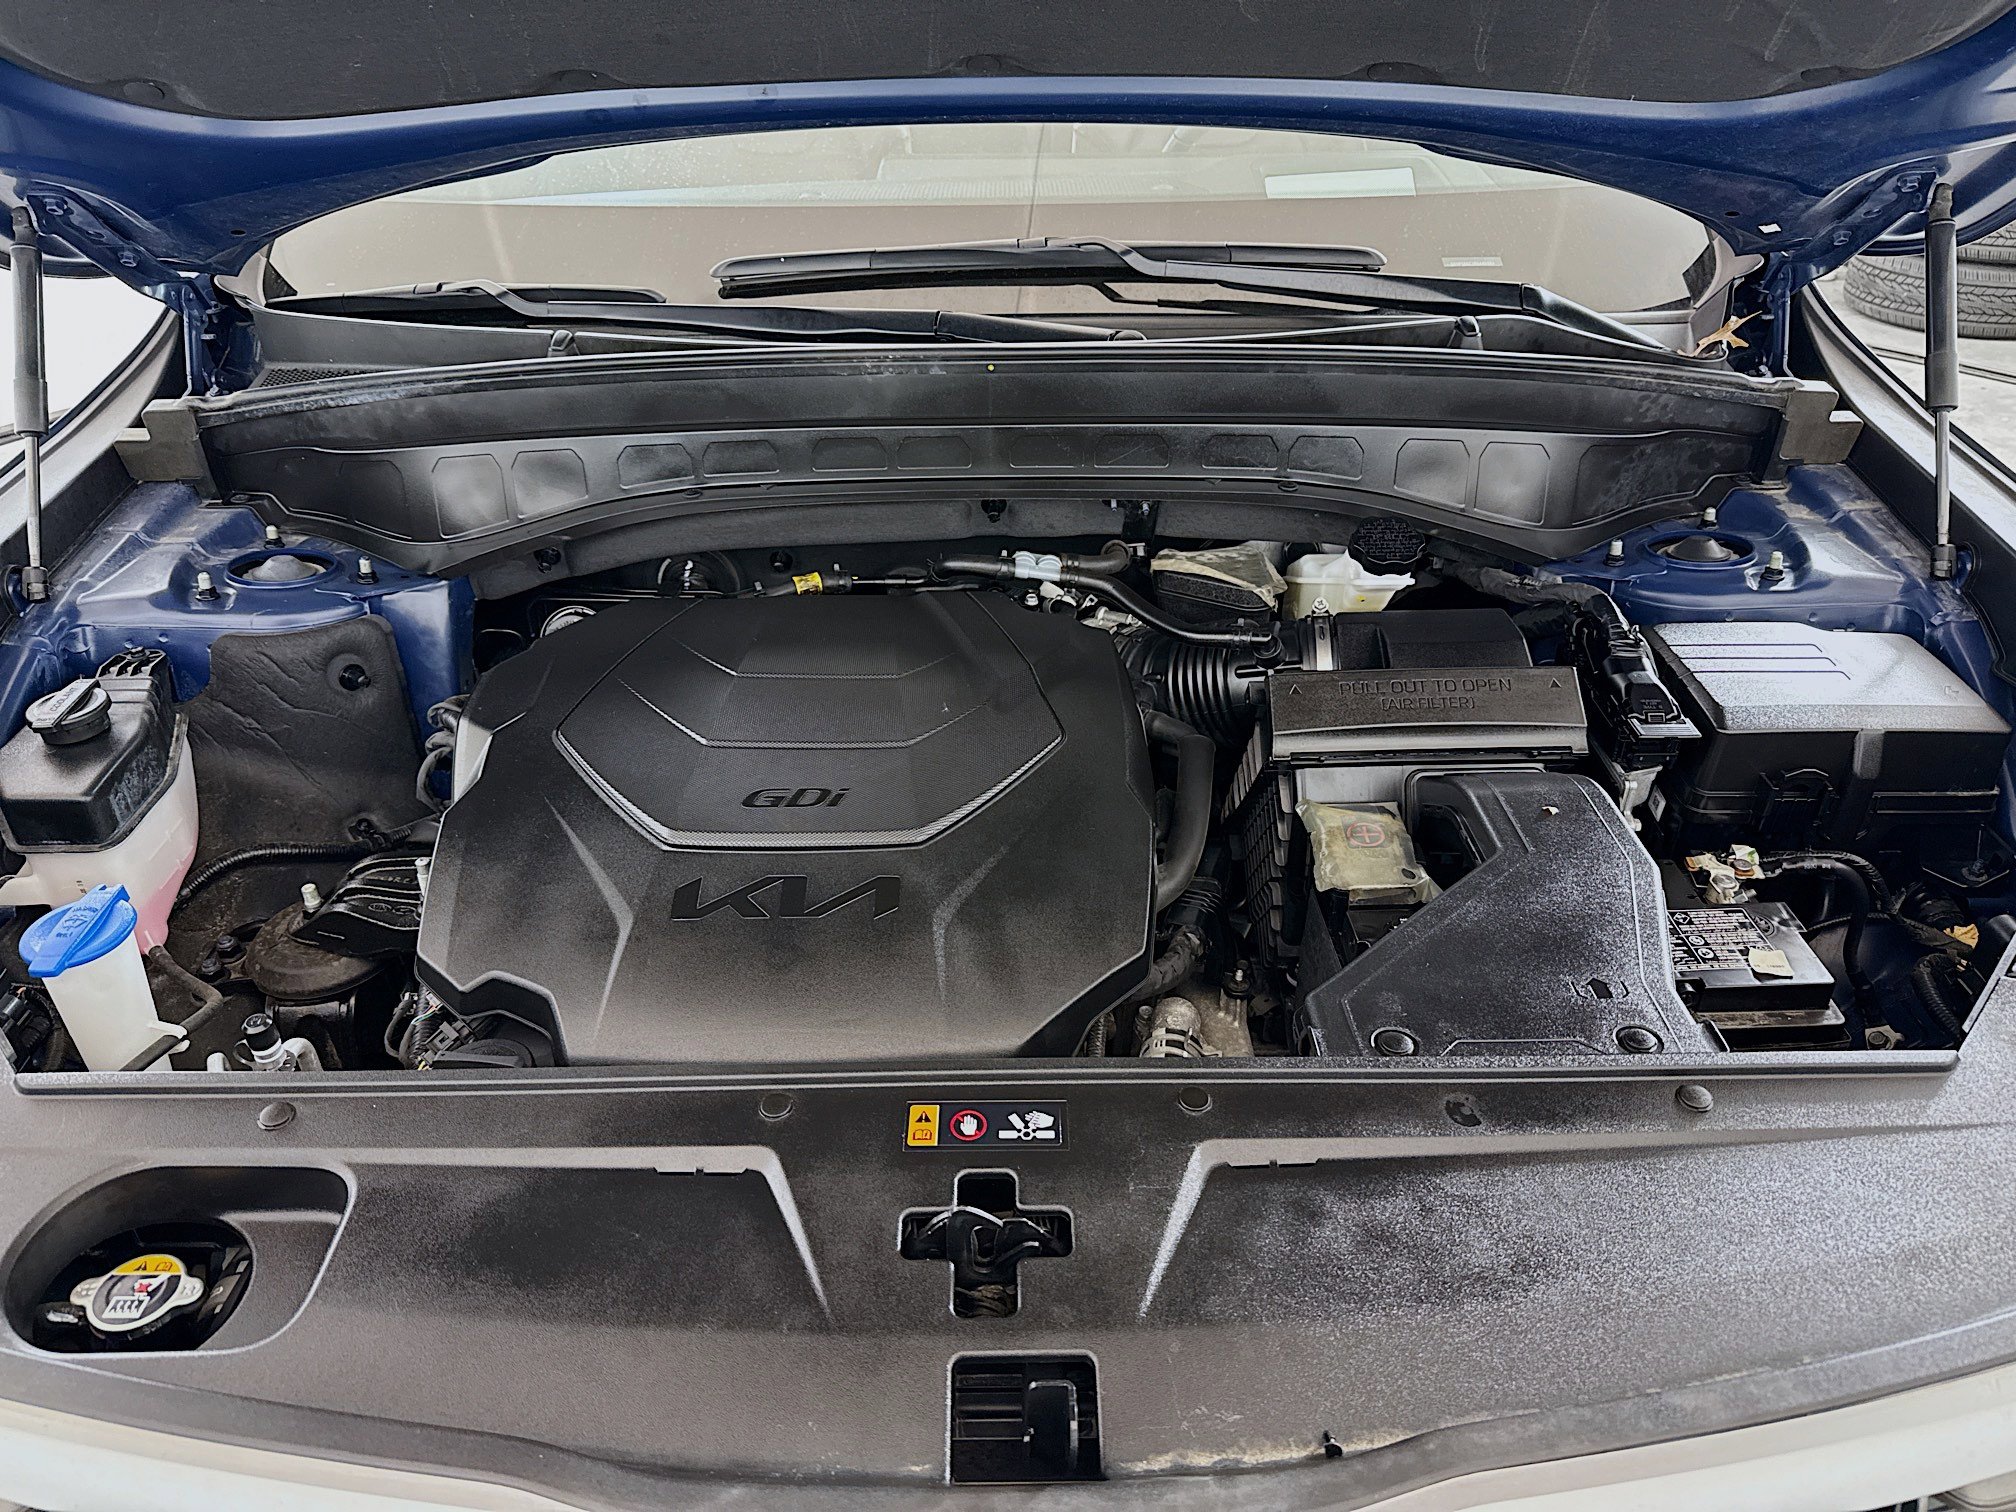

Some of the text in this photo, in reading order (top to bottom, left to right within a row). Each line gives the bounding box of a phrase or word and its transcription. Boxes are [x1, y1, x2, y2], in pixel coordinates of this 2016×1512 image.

[1338, 677, 1512, 695] PULL OUT TO OPEN
[742, 788, 850, 808] GDi
[671, 874, 900, 921] KIA
